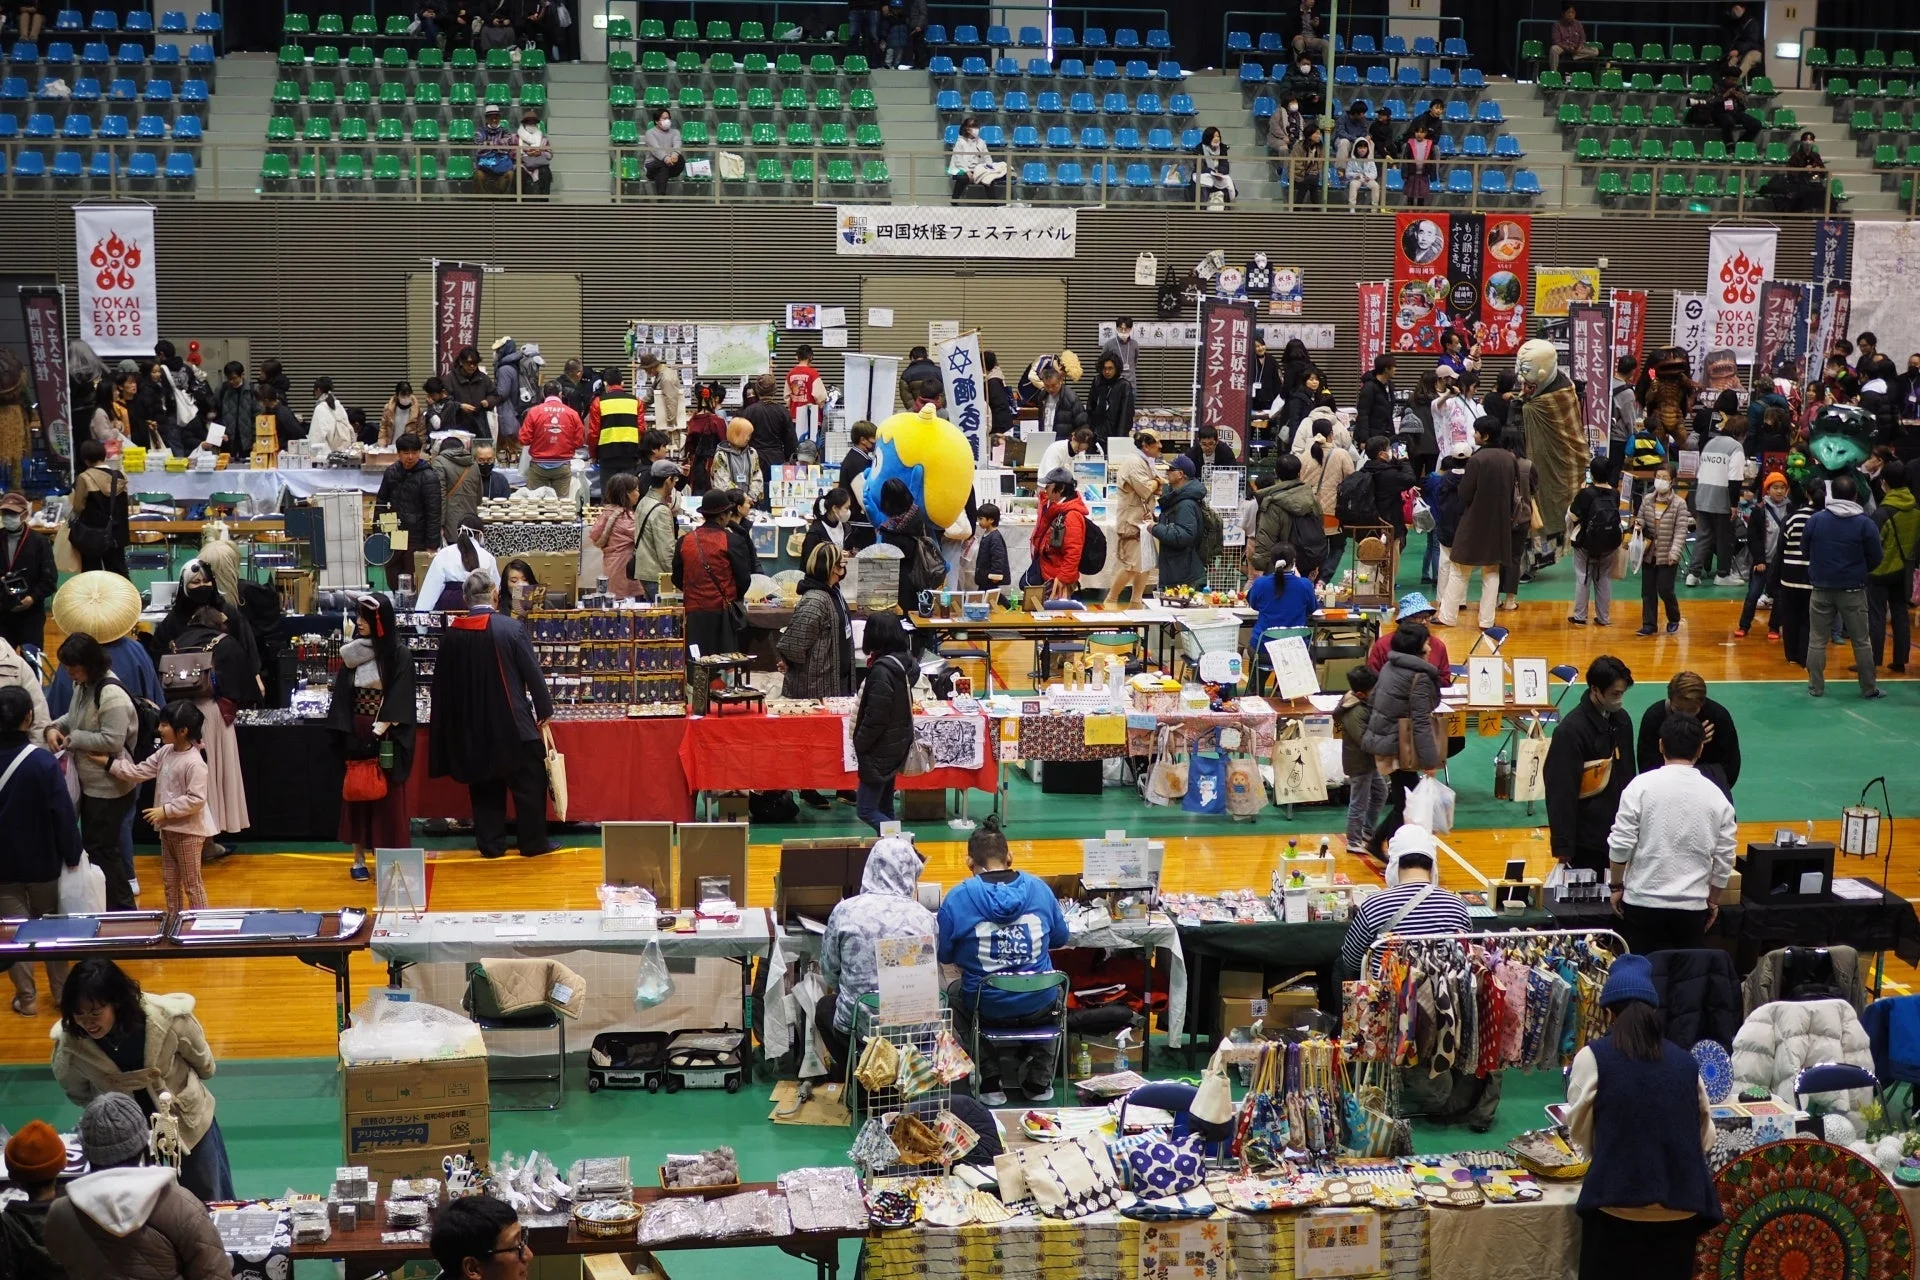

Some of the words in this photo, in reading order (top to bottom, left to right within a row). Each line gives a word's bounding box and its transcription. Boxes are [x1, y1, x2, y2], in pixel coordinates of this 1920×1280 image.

[876, 223, 1072, 241] 四国妖怪フェスティバル
[850, 235, 867, 245] Fes
[92, 297, 140, 309] YOKAI
[94, 310, 140, 323] EXPO
[458, 281, 477, 346] 四国妖怪
[1616, 301, 1632, 342] 福崎町
[94, 325, 141, 336] 2025
[1715, 323, 1755, 335] EXPO
[1714, 335, 1754, 347] 2025
[1230, 318, 1248, 391] 四国妖怪
[1204, 318, 1226, 424] フェスティバル
[1483, 716, 1497, 732] 六
[361, 1114, 420, 1126] 信頼のブランド
[356, 1127, 424, 1139] アリさんマークの
